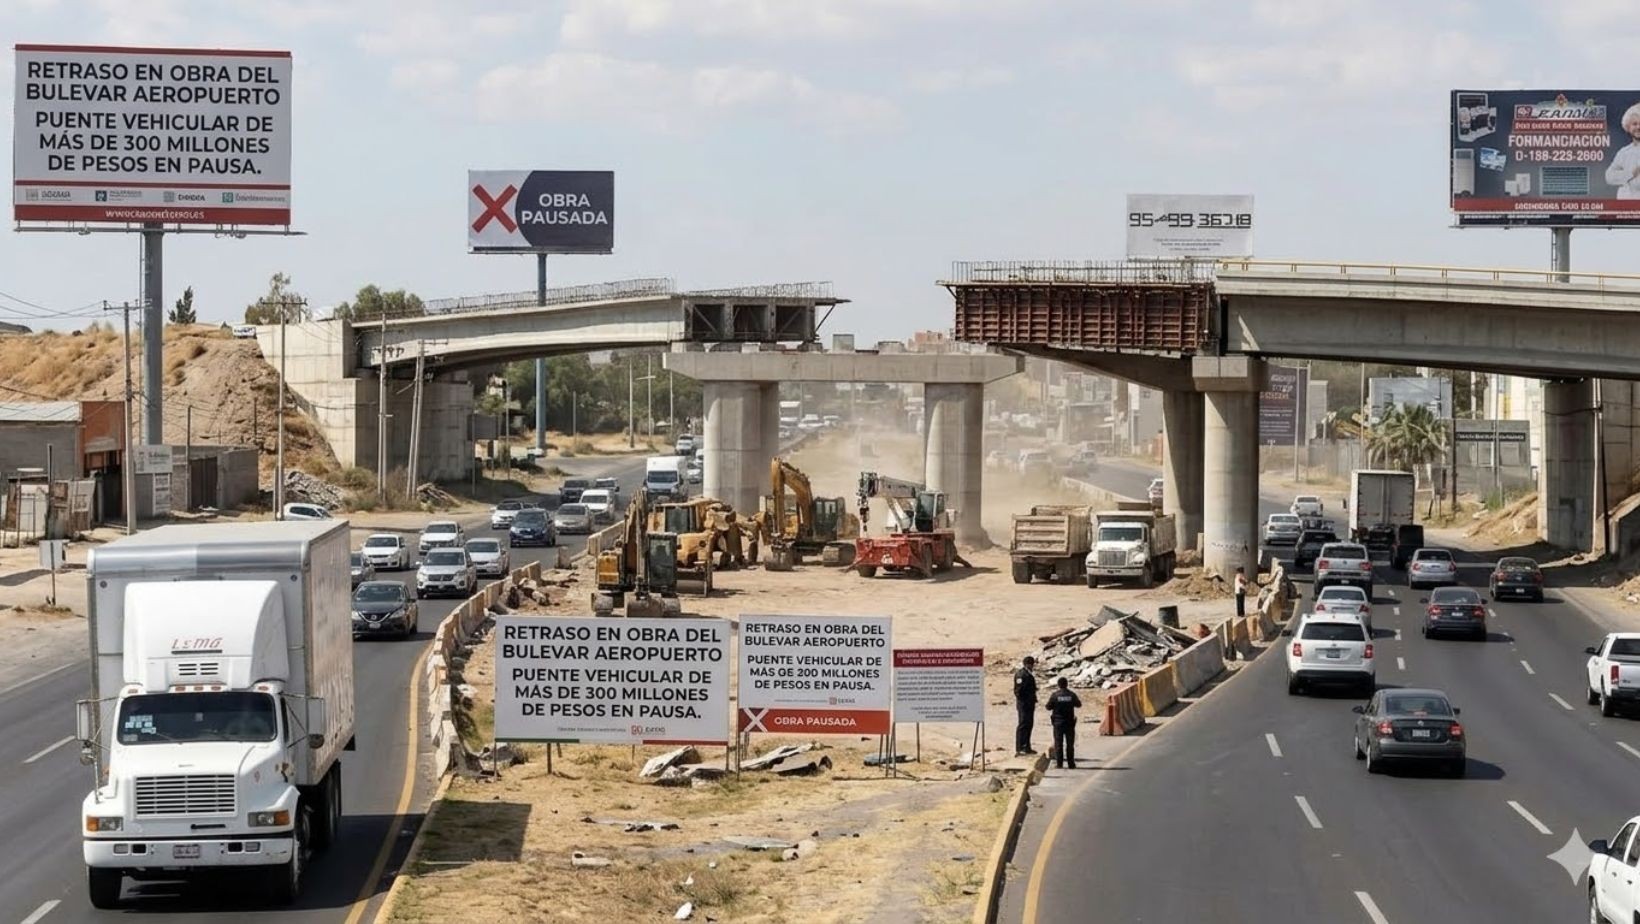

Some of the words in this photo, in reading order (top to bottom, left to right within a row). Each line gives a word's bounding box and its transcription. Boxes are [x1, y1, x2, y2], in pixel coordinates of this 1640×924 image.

[27, 61, 129, 81] RETRASO
[135, 63, 163, 81] EN
[169, 64, 232, 83] OBRA
[238, 65, 280, 84] DEL
[26, 82, 127, 102] BULEVAR
[132, 85, 281, 106] AEROPUERTO
[35, 111, 117, 130] PUENTE
[121, 112, 240, 132] VEHICULAR
[246, 115, 274, 133] DE
[39, 129, 85, 150] MÁS
[90, 134, 118, 151] DE
[123, 134, 161, 152] 300
[167, 135, 270, 154] MILLONES
[48, 154, 76, 171] DE
[82, 155, 149, 173] PESOS
[154, 156, 181, 173] EN
[188, 157, 262, 175] PAUSA.
[538, 193, 591, 208] OBRA
[521, 210, 608, 225] PAUSADA
[504, 625, 591, 641] RETRASO
[596, 626, 621, 641] EN
[626, 627, 681, 643] OBRA
[685, 628, 722, 643] DEL
[745, 622, 802, 634] RETRASO
[804, 623, 821, 634] EN
[823, 624, 859, 635] OBRA
[861, 624, 885, 635] DEL
[744, 635, 801, 647] BULEVAR
[802, 636, 886, 648] AEROPUERTO
[502, 644, 590, 660] BULEVAR
[594, 645, 723, 662] AEROPUERTO
[747, 654, 794, 665] PUENTE
[796, 655, 863, 666] VEHICULAR
[866, 656, 882, 667] DE
[512, 667, 581, 682] PUENTE
[584, 668, 683, 684] VEHICULAR
[688, 670, 712, 684] DE
[796, 667, 819, 678] 200
[515, 684, 553, 699] MÁS
[557, 685, 581, 700] DE
[585, 686, 617, 700] 300
[622, 687, 709, 702] MILLONES
[754, 679, 771, 689] DE
[773, 679, 811, 690] PESOS
[813, 680, 830, 690] EN
[522, 702, 545, 717] DE
[550, 703, 606, 718] PESOS
[611, 704, 634, 718] EN
[639, 704, 702, 719] PAUSA.
[773, 716, 805, 726] OBRA
[806, 716, 857, 727] PAUSADA
